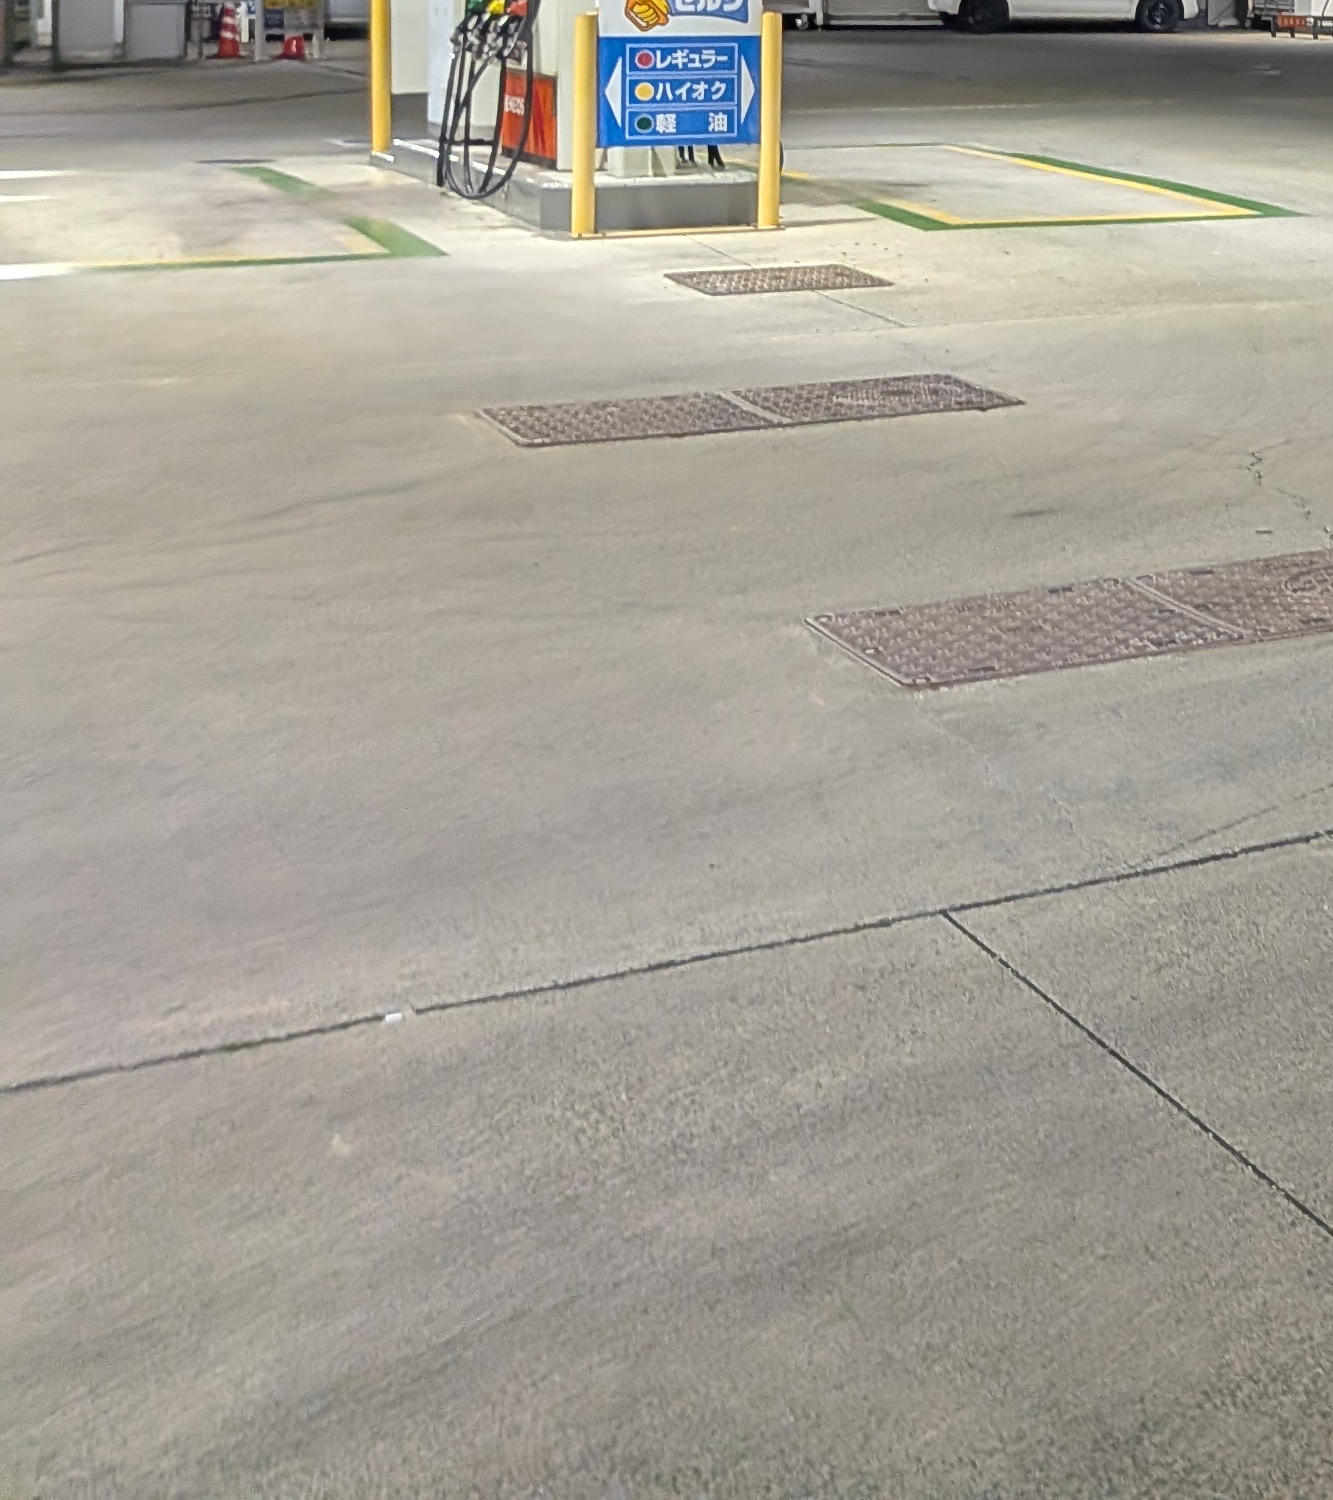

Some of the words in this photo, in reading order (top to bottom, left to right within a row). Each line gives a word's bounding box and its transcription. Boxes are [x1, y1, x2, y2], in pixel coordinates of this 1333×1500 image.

[655, 49, 729, 69] レギュラー
[655, 81, 728, 101] ハイオク
